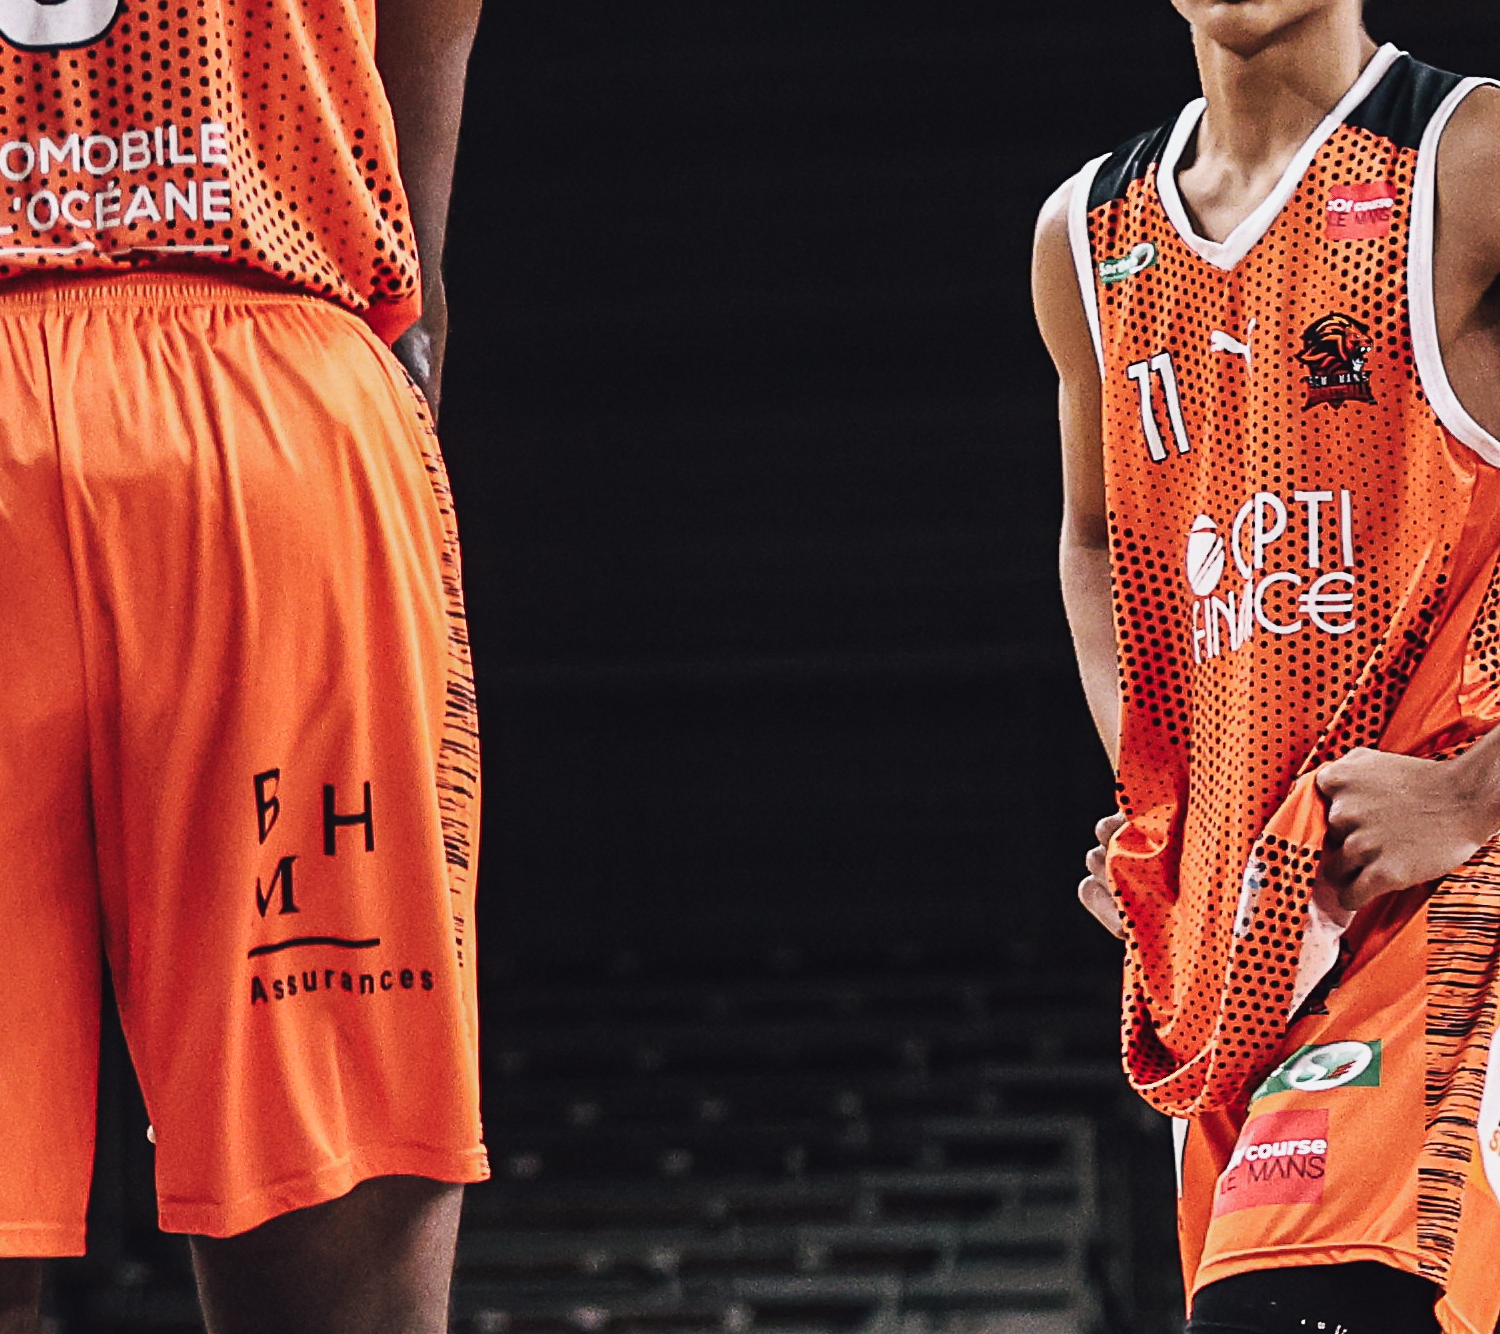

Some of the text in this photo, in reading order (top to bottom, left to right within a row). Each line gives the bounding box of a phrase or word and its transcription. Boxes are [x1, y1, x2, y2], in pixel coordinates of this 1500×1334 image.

[1127, 352, 1190, 462] 11
[251, 968, 434, 1005] Assurances
[1245, 1138, 1328, 1162] course
[1247, 1155, 1326, 1182] MANS
